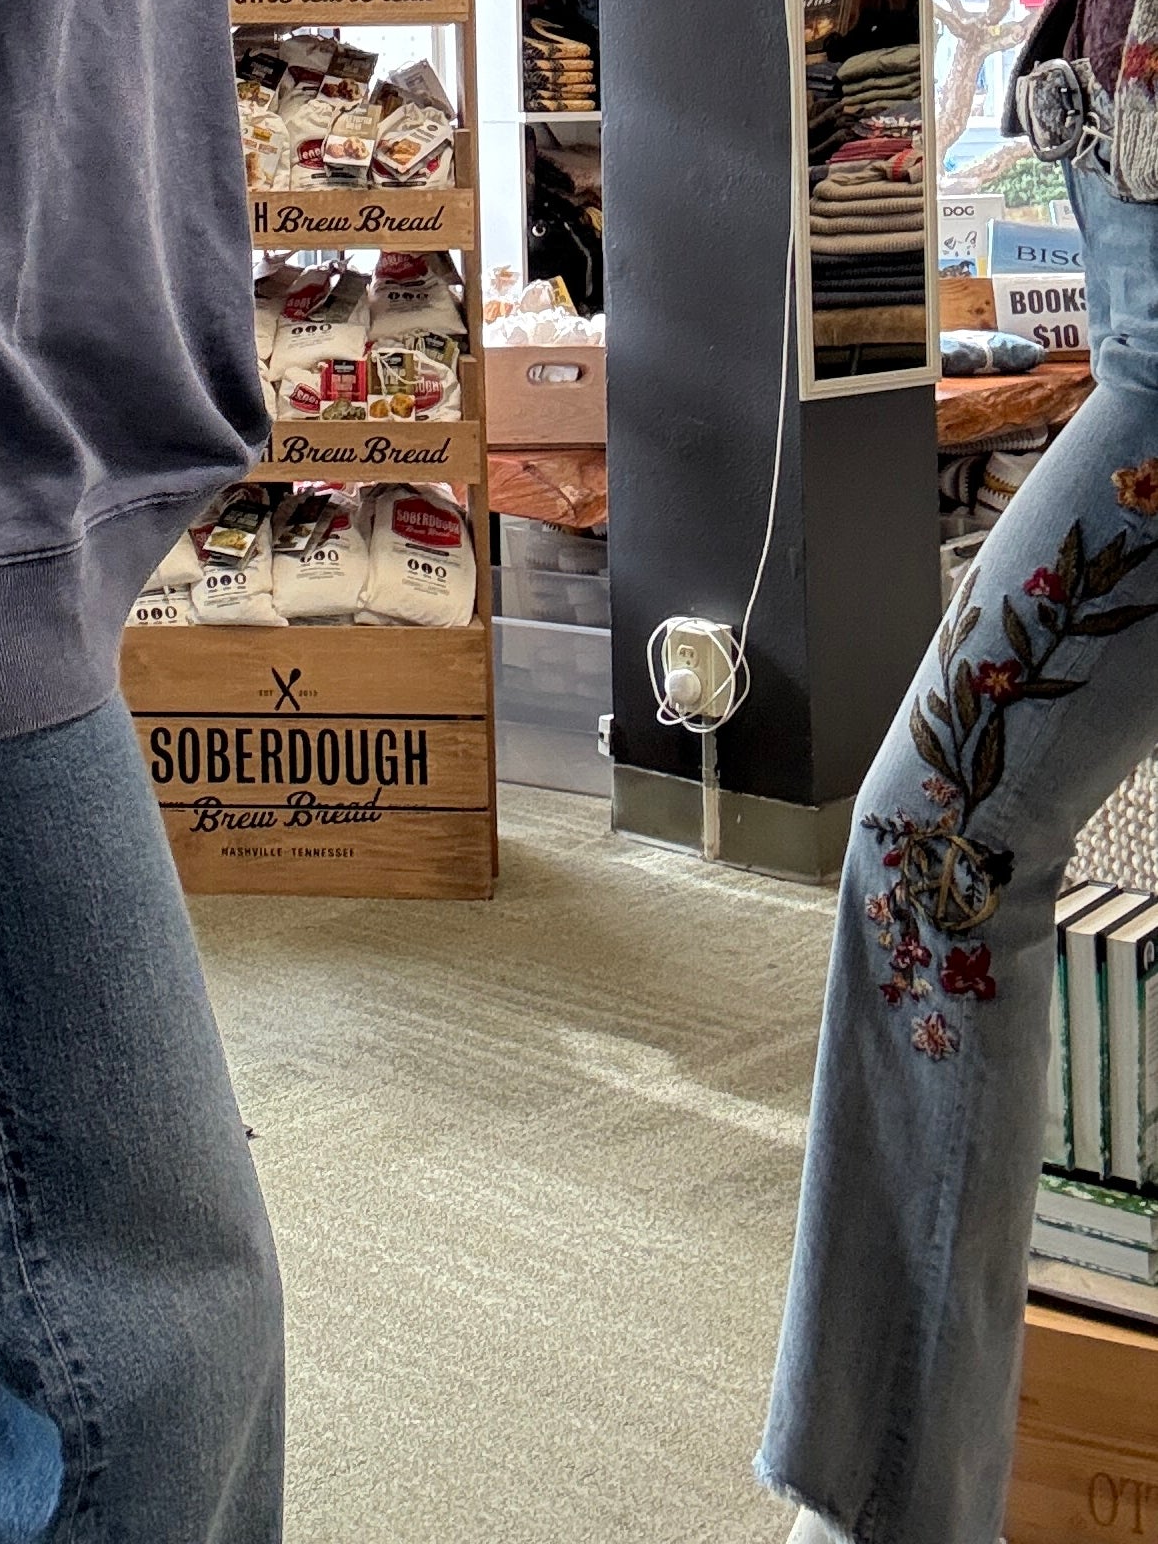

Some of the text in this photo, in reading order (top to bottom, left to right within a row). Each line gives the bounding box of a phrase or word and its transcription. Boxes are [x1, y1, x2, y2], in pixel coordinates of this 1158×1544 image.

[273, 205, 352, 233] Brew
[354, 205, 445, 233] Bread
[943, 205, 975, 217] DOG
[1033, 323, 1080, 350] $10
[278, 436, 357, 464] Brew
[360, 436, 452, 464] Bread
[150, 726, 429, 786] SOBERDOUGH
[189, 786, 383, 833] Brew Bread
[221, 847, 355, 858] NASHVILLE TENNESSEE
[1088, 1472, 1158, 1535] OT
